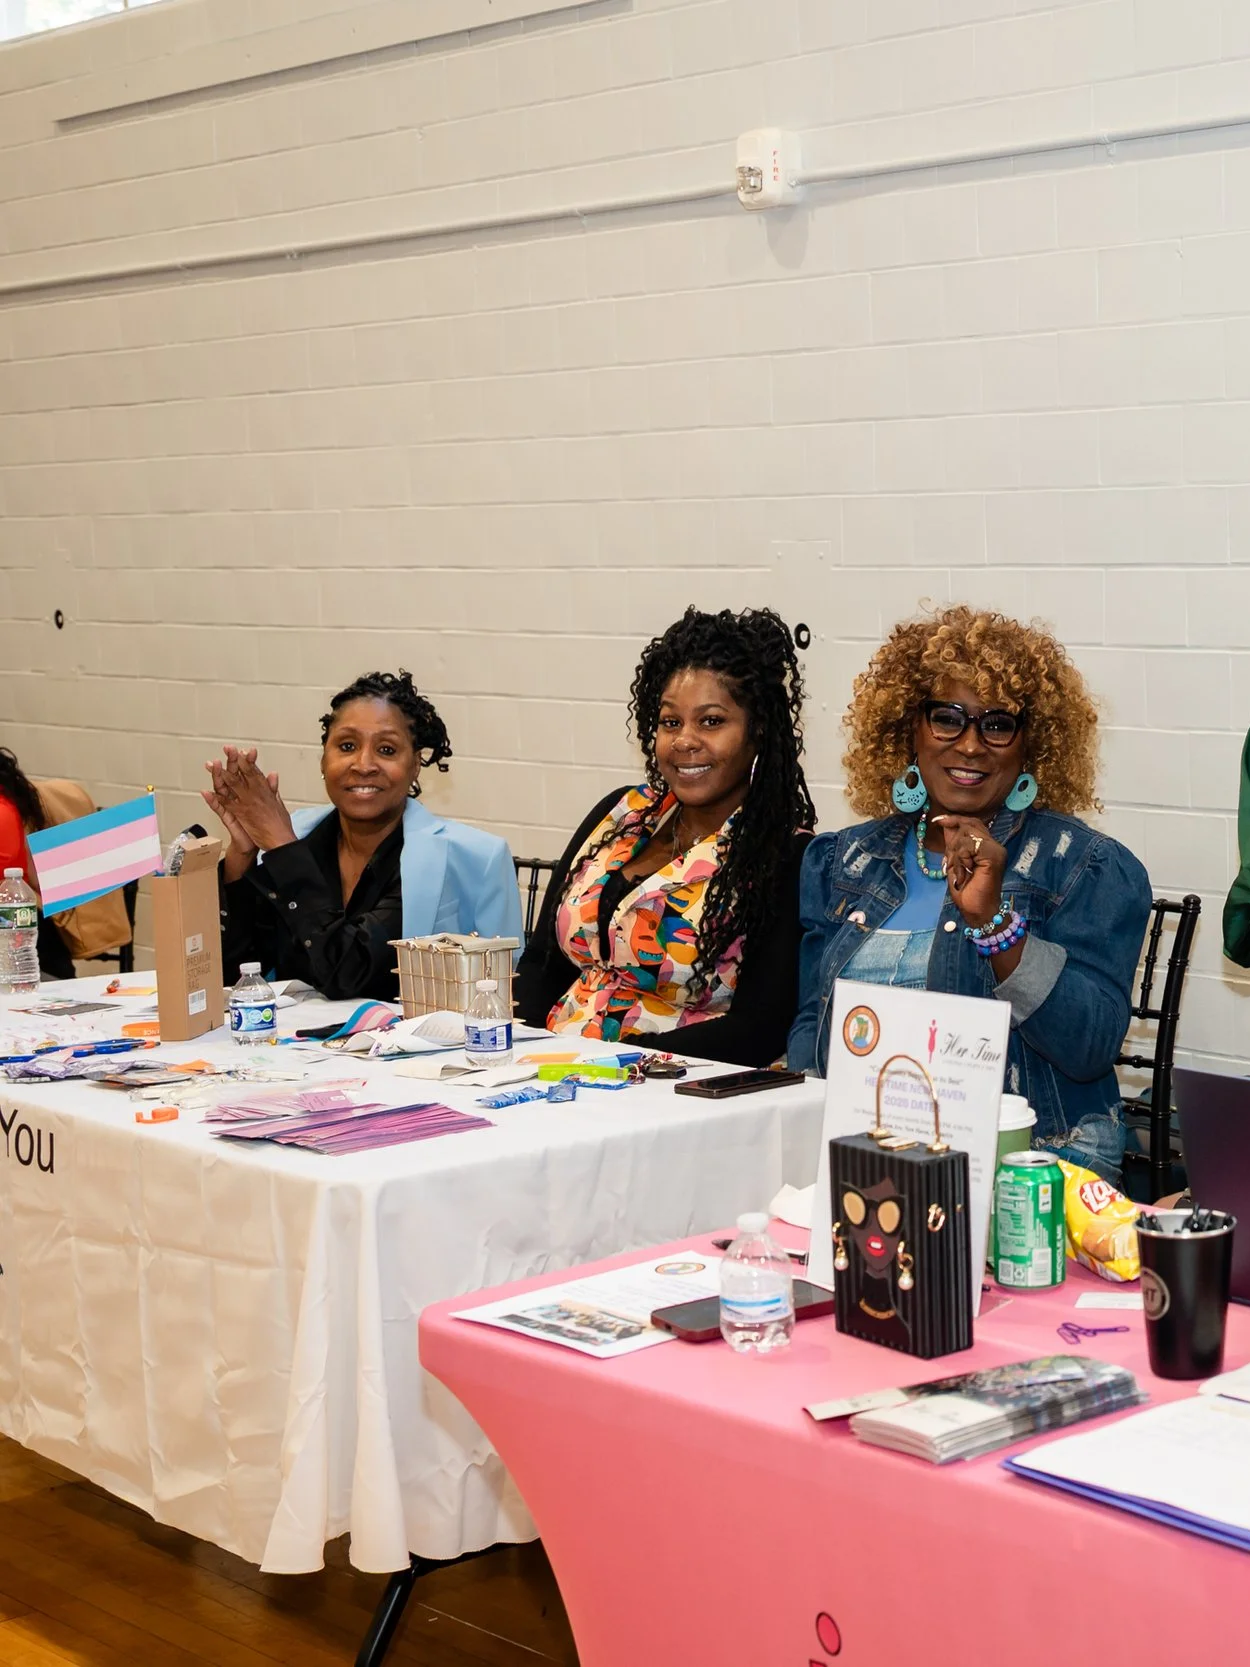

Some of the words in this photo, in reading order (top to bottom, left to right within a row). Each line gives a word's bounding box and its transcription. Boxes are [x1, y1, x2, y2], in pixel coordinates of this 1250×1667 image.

[940, 1032, 968, 1058] Her
[971, 1037, 1002, 1063] Time
[0, 1109, 54, 1174] You
